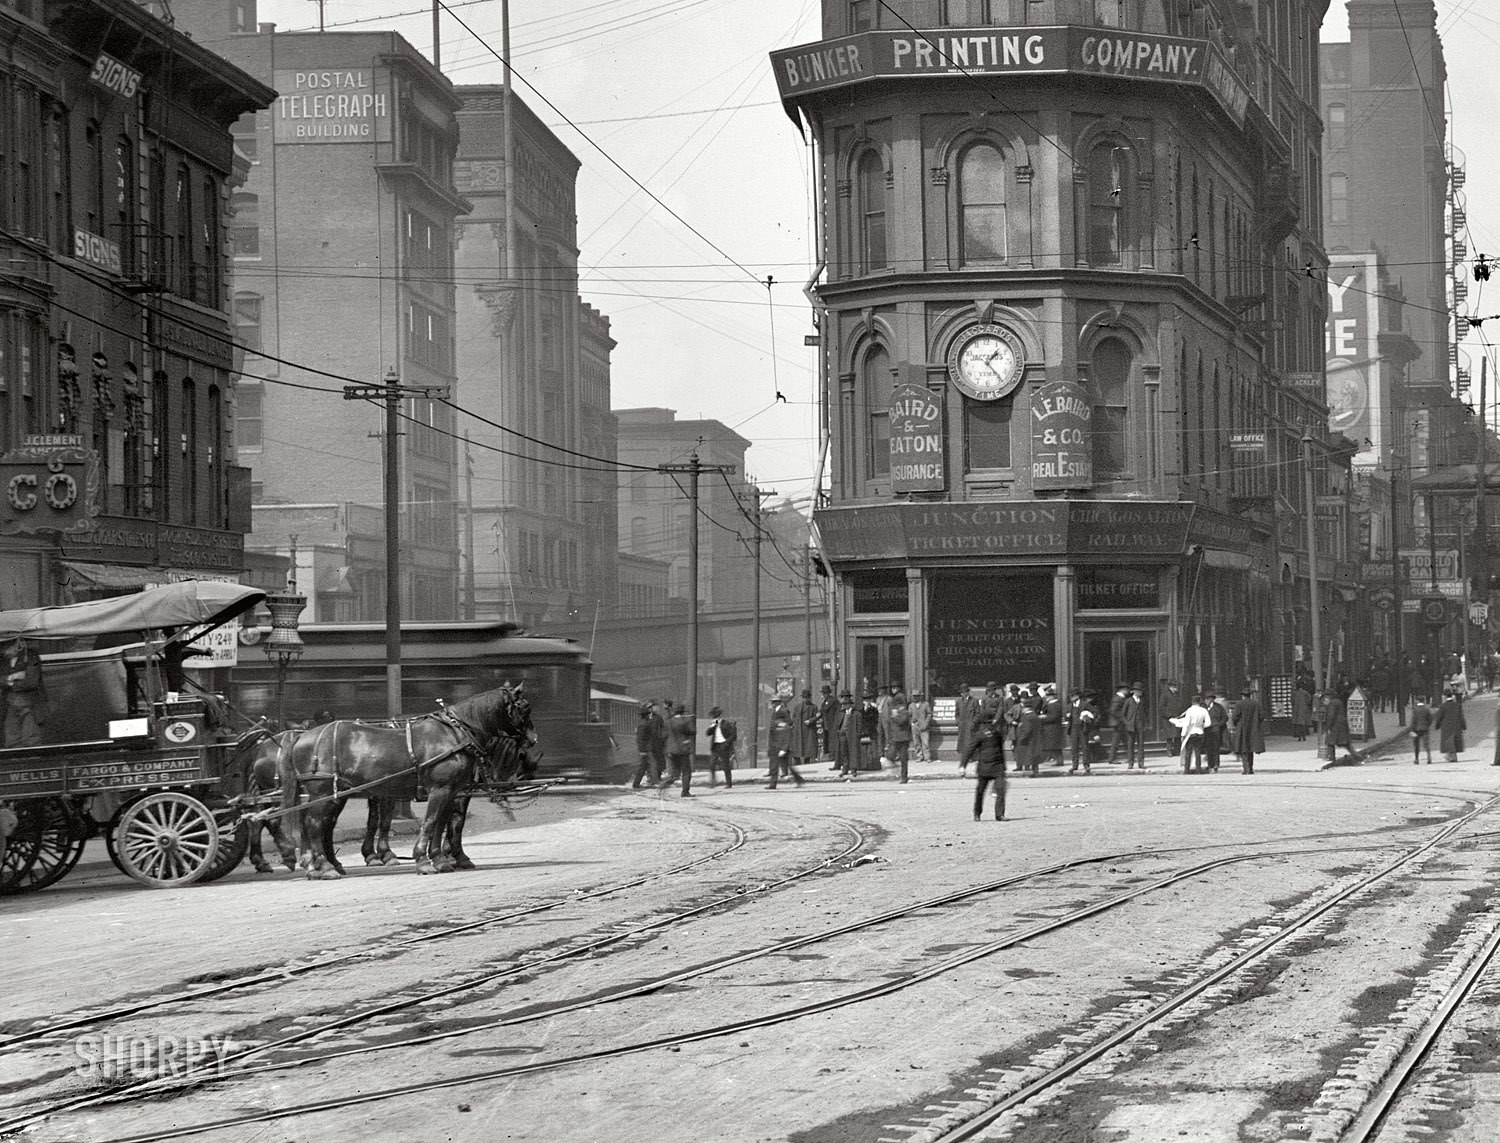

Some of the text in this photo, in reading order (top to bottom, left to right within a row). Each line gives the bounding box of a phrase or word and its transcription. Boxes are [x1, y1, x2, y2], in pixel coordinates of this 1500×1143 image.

[784, 35, 1198, 87] BUNKER PRINTING COMPANY.
[91, 55, 141, 98] SIGNS
[296, 72, 368, 88] POSTAL
[278, 94, 386, 118] TELEGRAPH
[296, 123, 370, 137] BUILDING
[75, 229, 121, 271] SIGNS
[975, 388, 1002, 399] TIME
[890, 399, 939, 424] BAIRD
[903, 420, 914, 432] &
[1043, 428, 1084, 444] & CO.
[1032, 462, 1058, 477] REAL
[919, 508, 1057, 527] JUNCTION
[908, 536, 982, 549] TICKET
[1079, 583, 1157, 594] TICKET OFFICE
[934, 617, 1049, 630] JUNCTION
[991, 632, 1034, 641] OFFICE
[936, 645, 993, 656] CHICAGO
[1005, 645, 1048, 655] ALTON
[10, 760, 194, 782] WELLS FARGO & COMPANY
